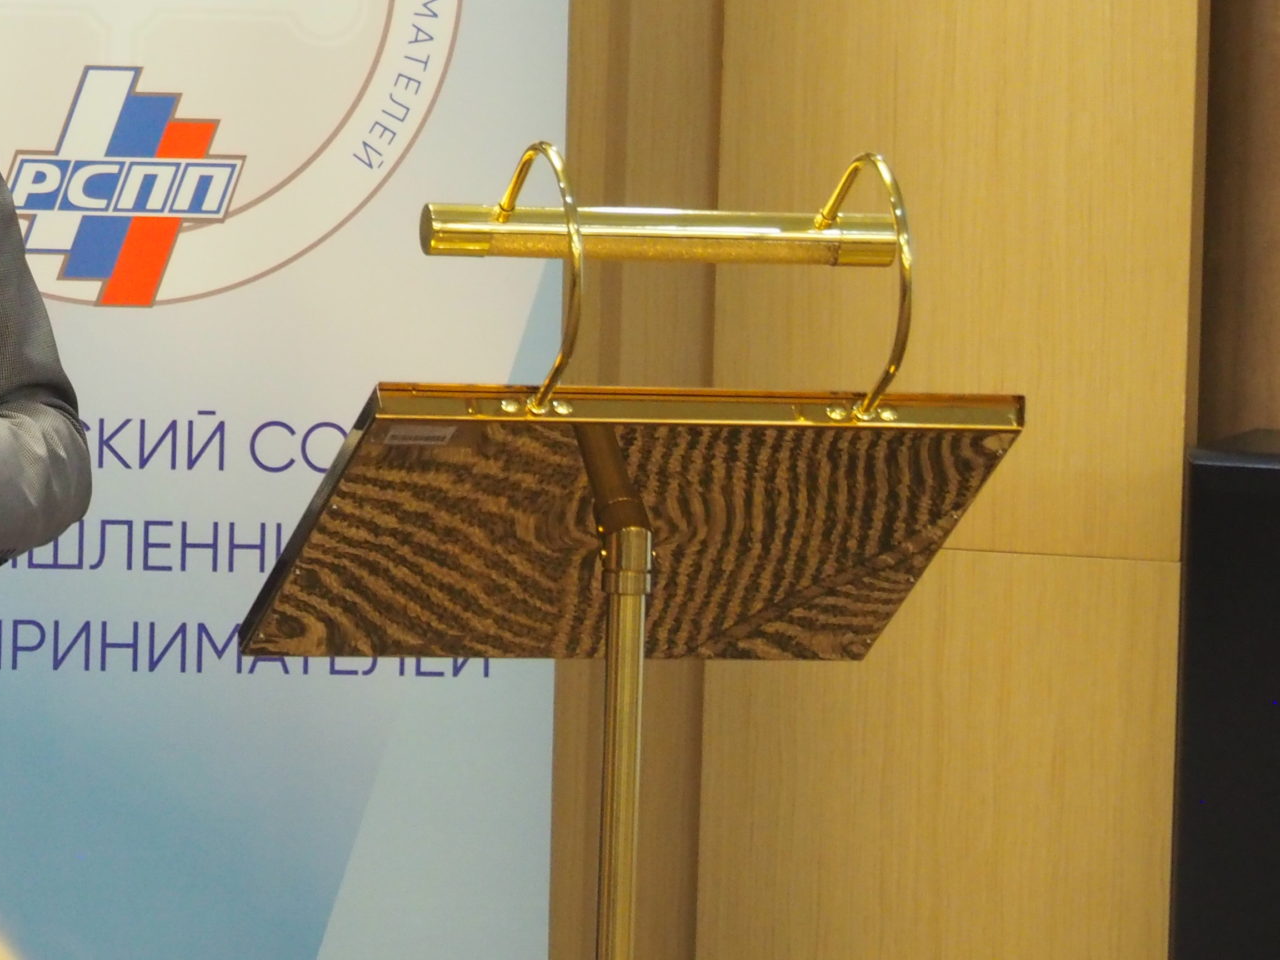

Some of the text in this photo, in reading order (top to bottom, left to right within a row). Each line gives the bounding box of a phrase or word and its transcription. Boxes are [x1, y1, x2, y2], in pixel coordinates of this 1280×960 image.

[12, 161, 233, 212] РСПП
[81, 409, 349, 473] КИЙ СО
[11, 519, 293, 573] ШЛЕНН
